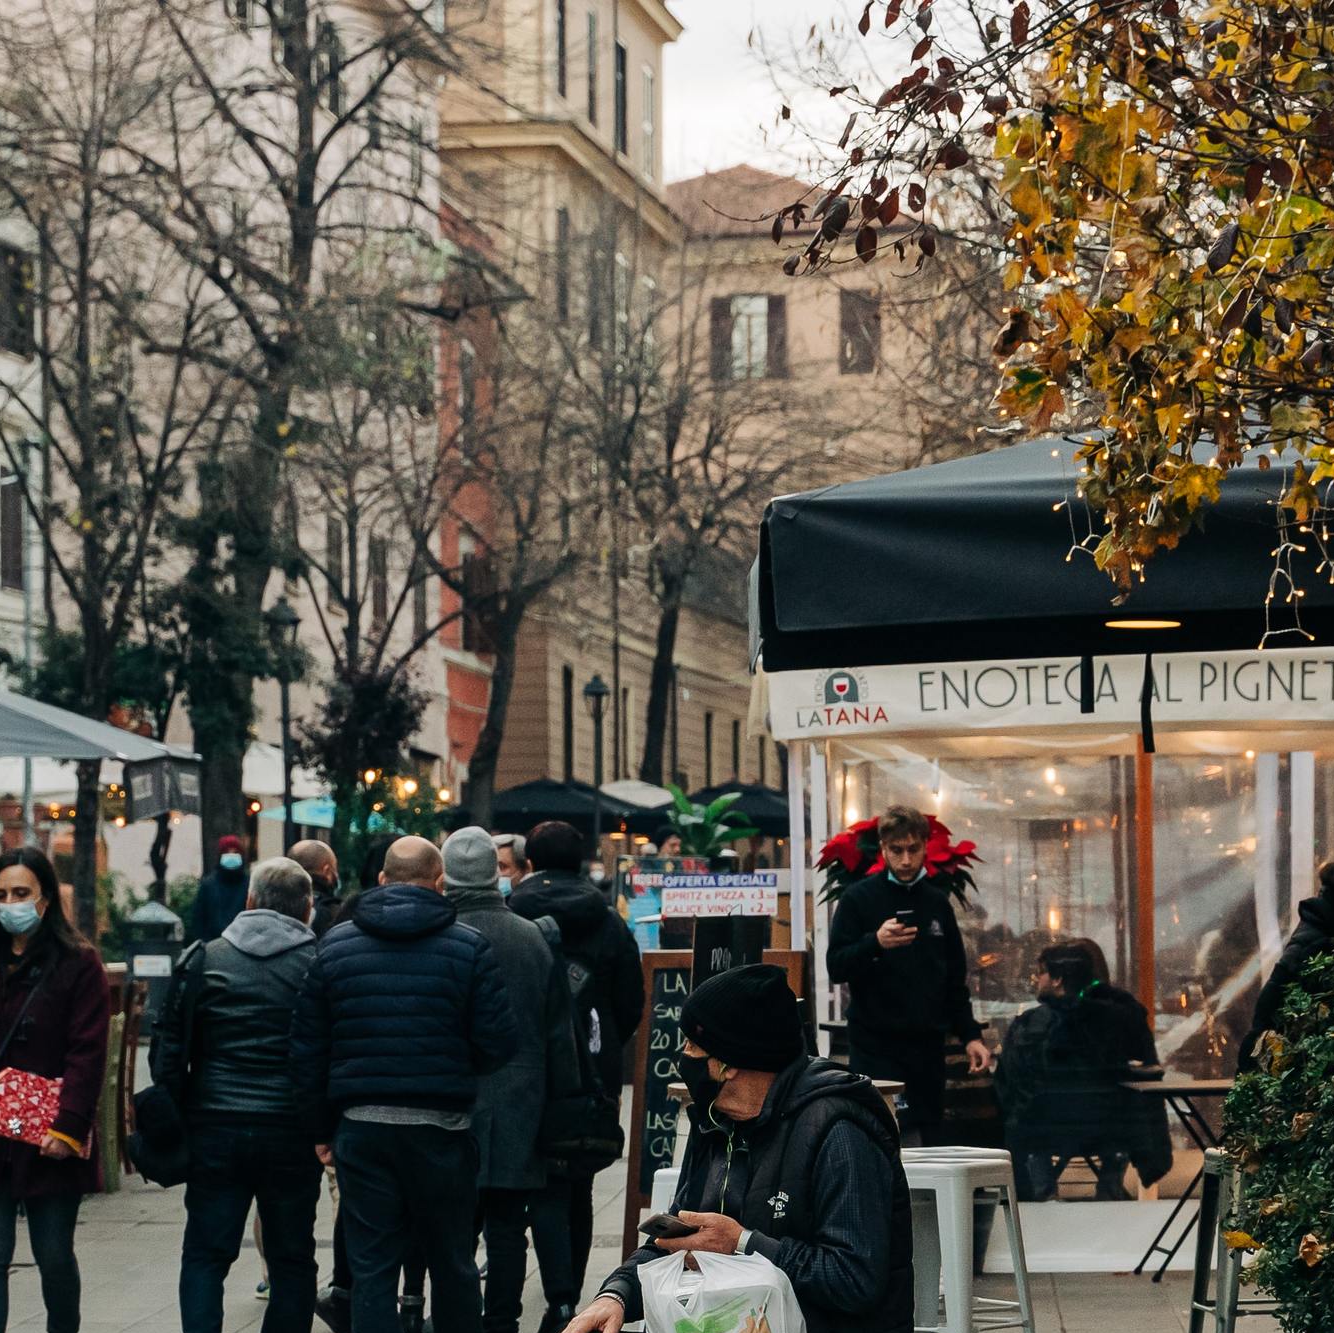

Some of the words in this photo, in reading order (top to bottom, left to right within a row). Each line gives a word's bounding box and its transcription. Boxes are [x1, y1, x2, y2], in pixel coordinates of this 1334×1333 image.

[919, 661, 1118, 711] ENOTECA
[1138, 660, 1183, 702] AL
[666, 875, 716, 887] OFFERTA
[718, 874, 775, 887] SPECIALE
[667, 891, 702, 901] SPRITZ
[715, 890, 744, 900] PIZZA
[666, 903, 702, 913] CALICE
[650, 1028, 671, 1050] 20
